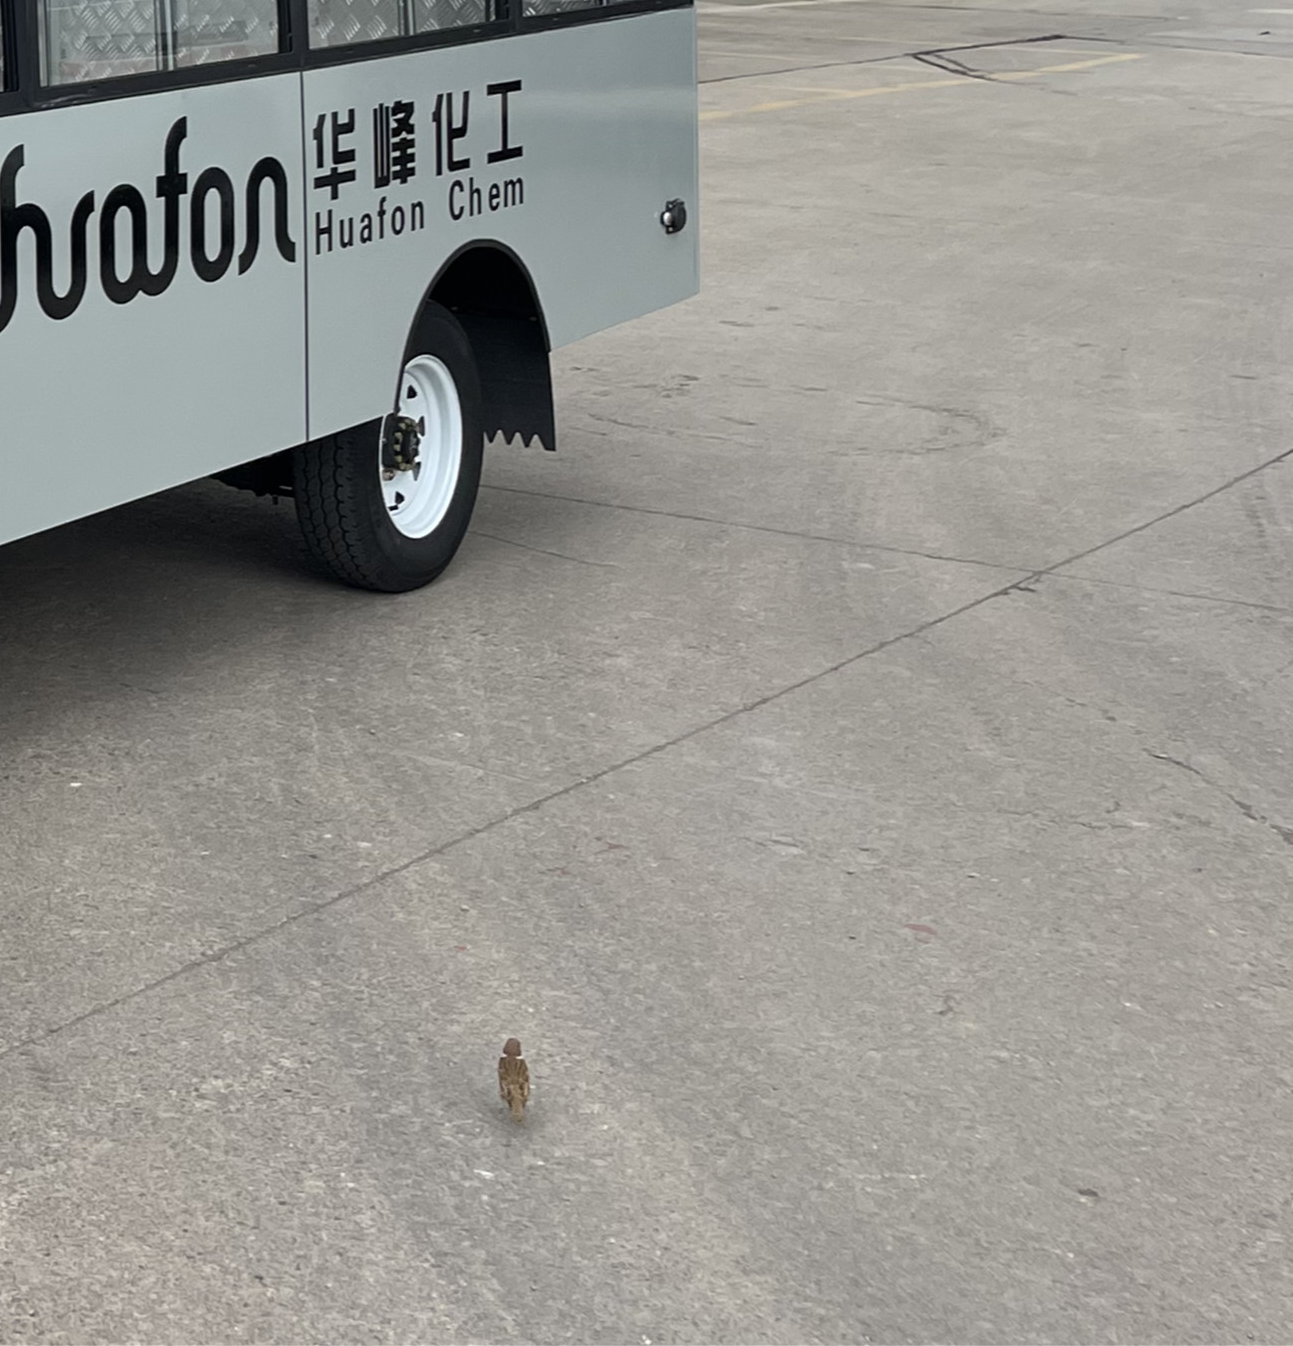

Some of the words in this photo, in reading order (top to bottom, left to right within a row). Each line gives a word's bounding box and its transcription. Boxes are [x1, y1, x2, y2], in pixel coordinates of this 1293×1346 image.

[313, 80, 524, 201] 华峰化工
[315, 196, 425, 256] Huafon
[448, 176, 525, 222] Chem
